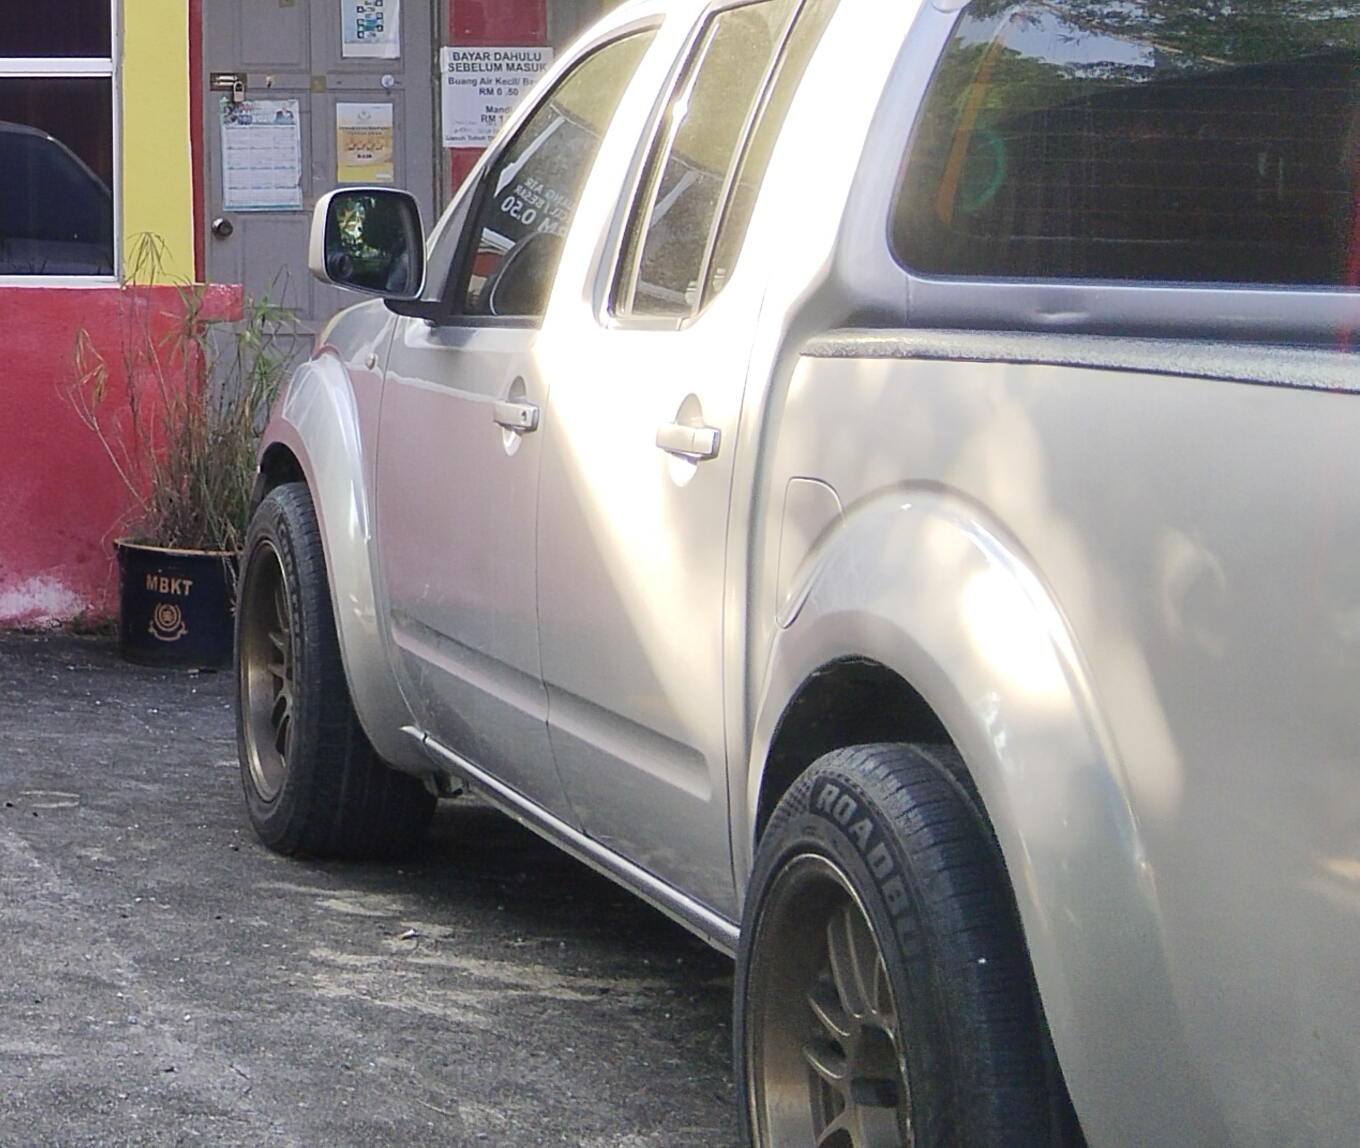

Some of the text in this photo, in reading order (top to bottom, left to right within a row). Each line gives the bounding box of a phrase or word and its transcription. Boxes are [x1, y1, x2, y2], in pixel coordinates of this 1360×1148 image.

[452, 51, 543, 61] BAYAR DAHULU
[447, 62, 549, 72] SEBELUM MASUK
[447, 77, 478, 87] Buang
[479, 77, 494, 86] Air
[478, 87, 494, 97] RM
[480, 114, 497, 123] RM
[145, 573, 194, 597] MBKT
